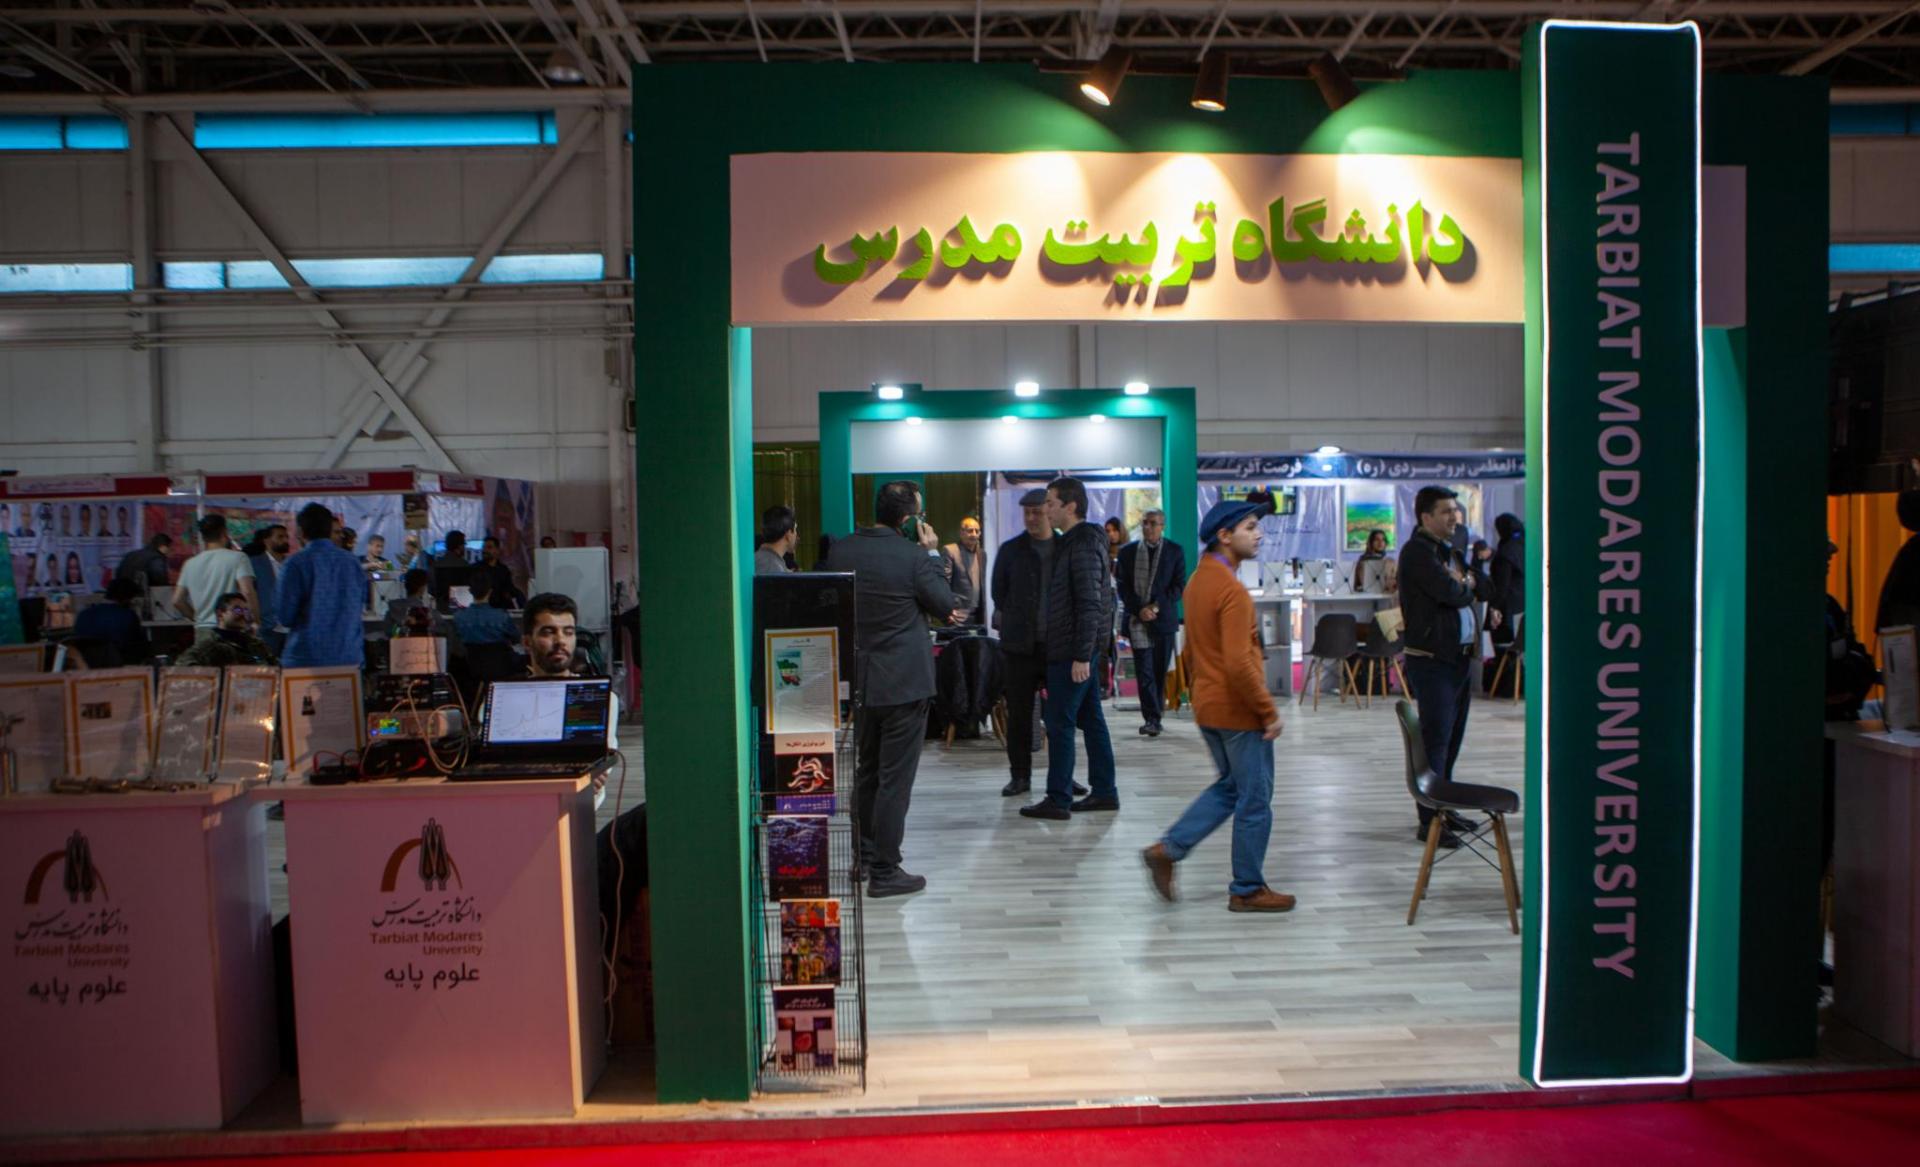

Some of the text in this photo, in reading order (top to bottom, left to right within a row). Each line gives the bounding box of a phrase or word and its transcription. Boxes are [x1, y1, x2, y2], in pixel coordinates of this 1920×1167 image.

[814, 196, 1465, 286] دانشگاه تربیت مدرس
[1262, 457, 1302, 478] فرصت
[1356, 458, 1385, 477] (ره)
[1468, 458, 1516, 477] العظمی
[1592, 132, 1642, 980] TARBIAT MODARES UNIVERSITY
[94, 908, 128, 937] دانشگاه
[372, 896, 482, 928] دانشگاه تربیت مدرس
[52, 912, 96, 941] تربیت
[370, 930, 483, 945] Tarbiat Modares
[14, 943, 130, 957] Tarbiat Modares
[67, 956, 130, 969] University
[422, 944, 483, 956] University
[384, 961, 480, 991] علوم پایه
[28, 974, 128, 1006] علوم پایه
